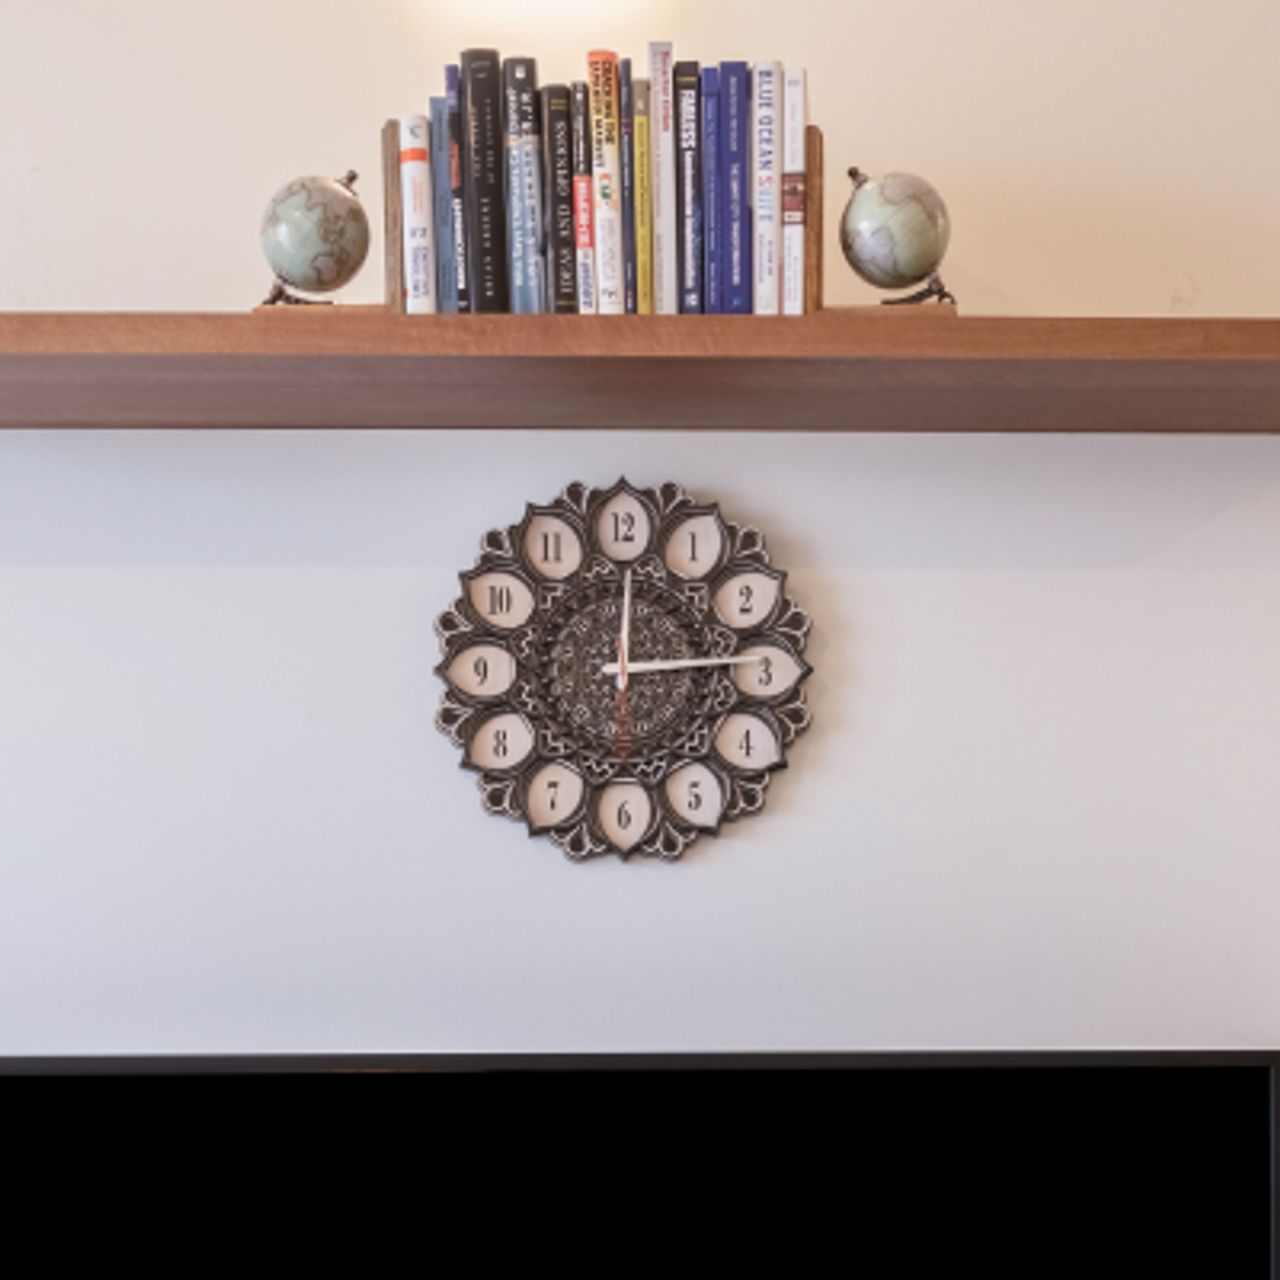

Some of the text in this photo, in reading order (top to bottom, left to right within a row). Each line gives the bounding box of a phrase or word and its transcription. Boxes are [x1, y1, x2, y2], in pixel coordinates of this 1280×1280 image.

[758, 70, 773, 109] BLUE
[605, 122, 615, 145] THE
[758, 115, 774, 171] OCEAN
[555, 120, 573, 294] IDEAS AND OPINIONS
[610, 511, 635, 543] 12
[541, 532, 562, 563] 11
[687, 532, 698, 563] 1
[488, 585, 513, 615] 10
[738, 585, 754, 614] 2
[473, 656, 488, 686] 9
[758, 656, 773, 687] 3
[492, 729, 508, 759] 8
[738, 728, 754, 757] 4
[547, 780, 559, 811] 7
[687, 781, 702, 811] 5
[616, 800, 632, 830] 6
